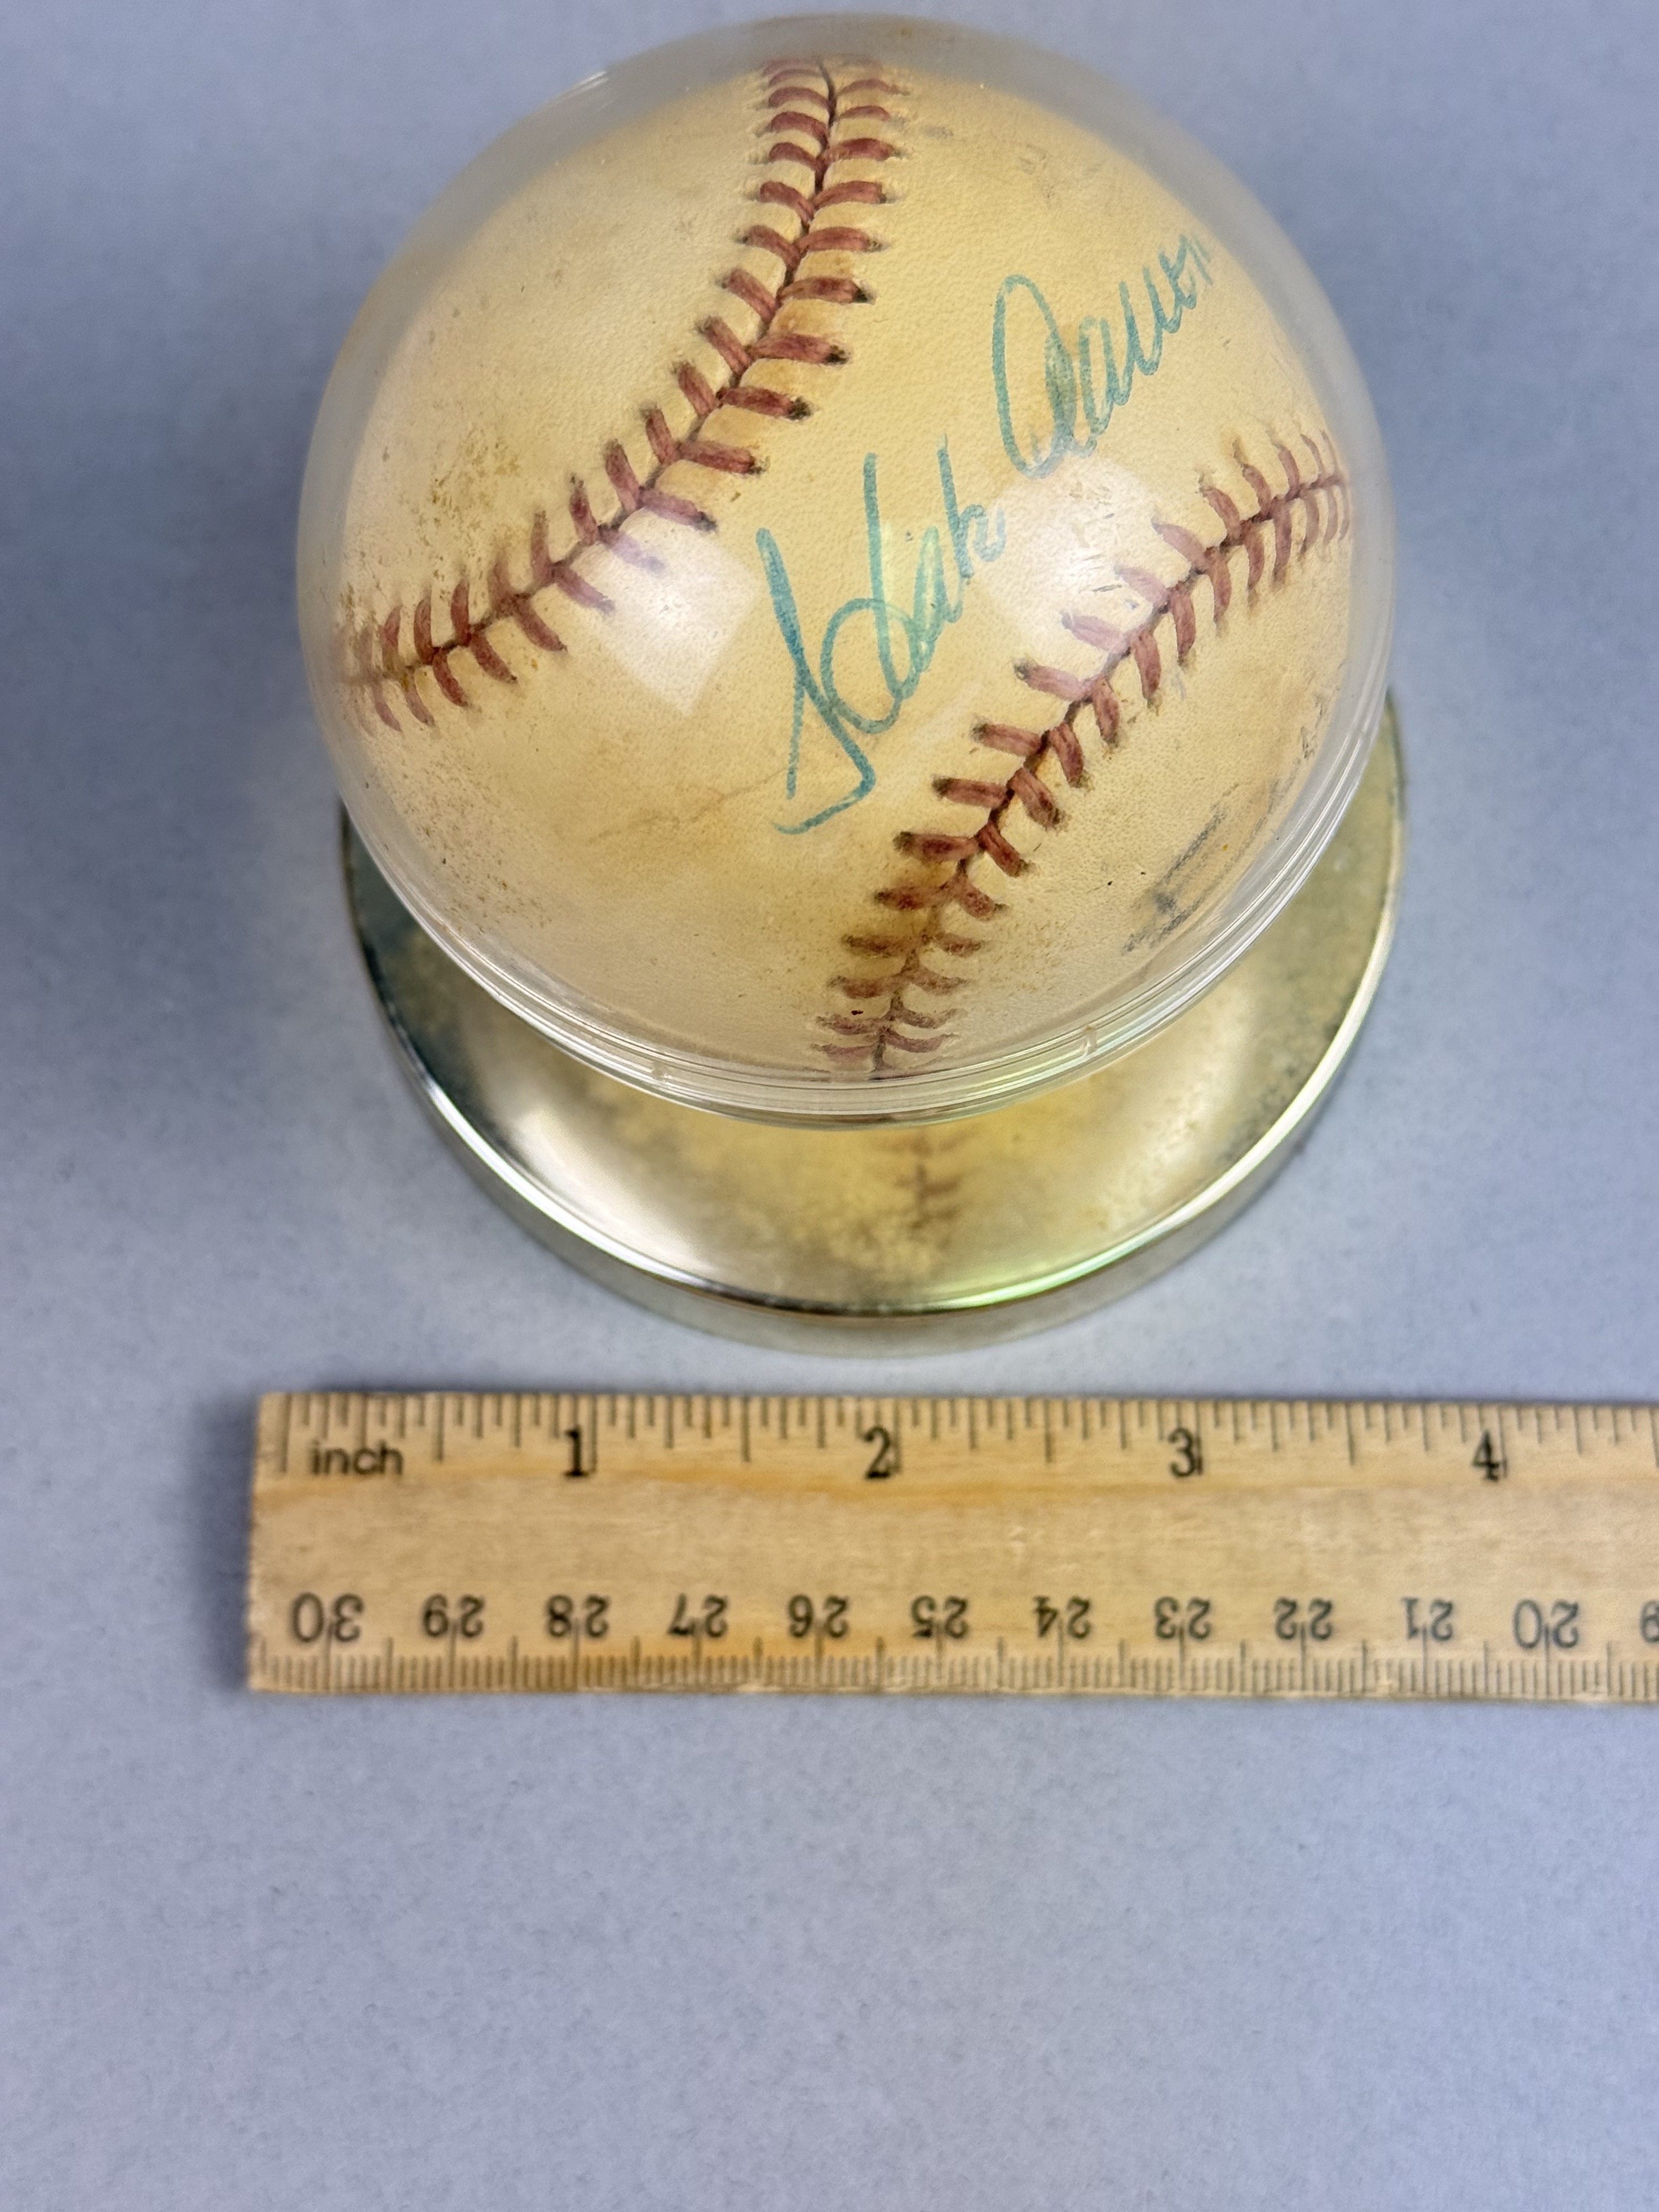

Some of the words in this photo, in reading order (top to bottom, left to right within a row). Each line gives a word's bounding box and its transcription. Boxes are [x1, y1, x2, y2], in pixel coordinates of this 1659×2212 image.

[311, 1441, 404, 1475] inch
[562, 1425, 589, 1477] 1
[861, 1426, 895, 1479] 2
[1168, 1427, 1196, 1478] 3
[1471, 1430, 1500, 1482] 4
[290, 1593, 365, 1642] 30
[422, 1593, 486, 1638] 29
[545, 1594, 611, 1638] 28
[667, 1593, 729, 1638] 27
[788, 1594, 849, 1639] 26
[910, 1595, 969, 1639] 25
[1033, 1595, 1093, 1640] 24
[1154, 1595, 1212, 1640] 23
[1274, 1597, 1334, 1640] 22
[1401, 1597, 1455, 1641] 21
[1513, 1599, 1580, 1649] 20
